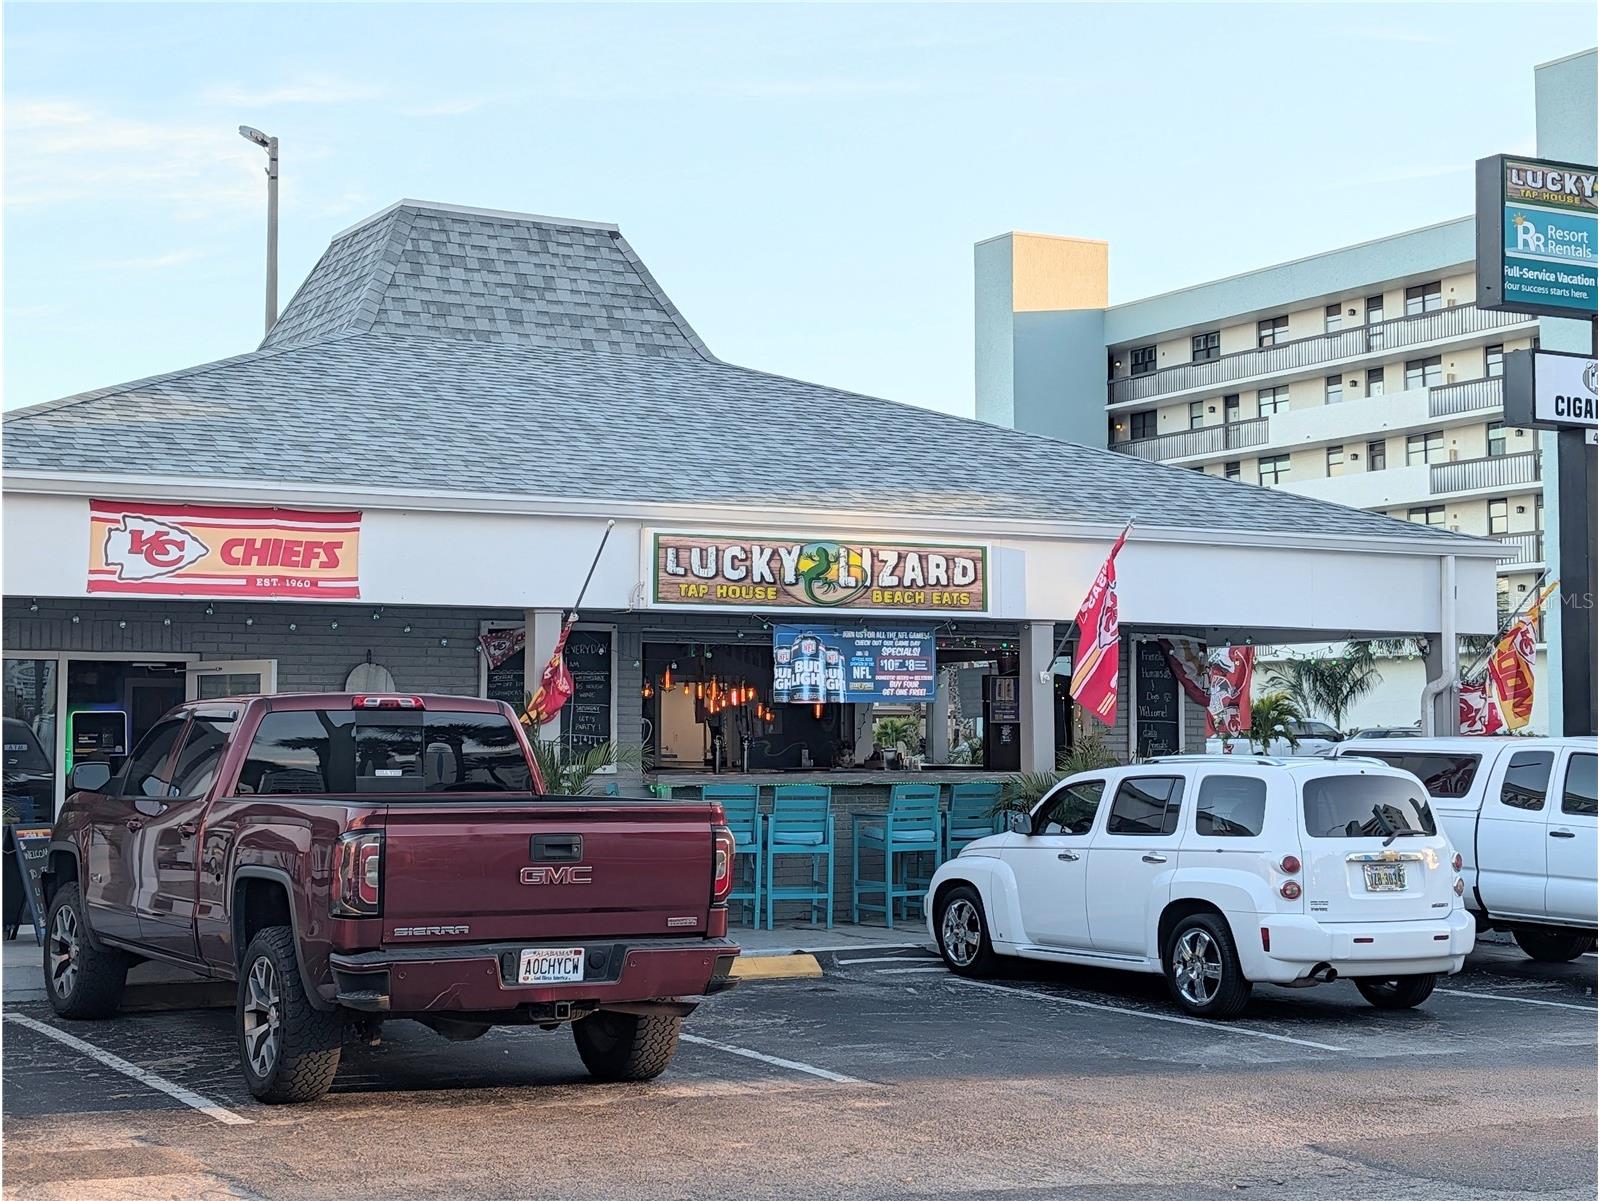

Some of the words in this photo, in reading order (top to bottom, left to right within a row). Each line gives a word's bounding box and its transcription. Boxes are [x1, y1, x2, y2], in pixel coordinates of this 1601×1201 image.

[1511, 168, 1596, 198] LUCKY
[1520, 189, 1538, 199] TAP
[1543, 192, 1581, 204] HOUSE
[1547, 225, 1589, 244] Resort
[1548, 240, 1592, 258] Rentals
[1504, 265, 1556, 282] Full-Service
[1557, 271, 1595, 287] Vacation
[1521, 284, 1549, 294] success
[1550, 286, 1570, 297] starts
[1571, 288, 1589, 299] here.
[1555, 395, 1598, 419] CIGA
[128, 529, 186, 568] KC
[220, 537, 344, 569] CHIEFS
[665, 545, 801, 586] LUCKY
[838, 545, 977, 588] LIZARD
[256, 578, 281, 587] EST.
[285, 579, 311, 588] 1960
[678, 584, 709, 598] TAP
[716, 584, 777, 600] HOUSE
[872, 589, 925, 604] BEACH
[931, 591, 971, 605] EATS
[876, 631, 886, 639] ALL
[803, 643, 816, 651] NFL
[881, 647, 921, 656] SPECIALS!
[795, 661, 821, 673] BUD
[852, 666, 872, 679] NFL
[880, 659, 895, 671] $10
[792, 672, 824, 685] LIGH
[24, 847, 49, 860] WELCOM
[520, 866, 593, 886] GMC
[394, 925, 470, 937] SIERRA
